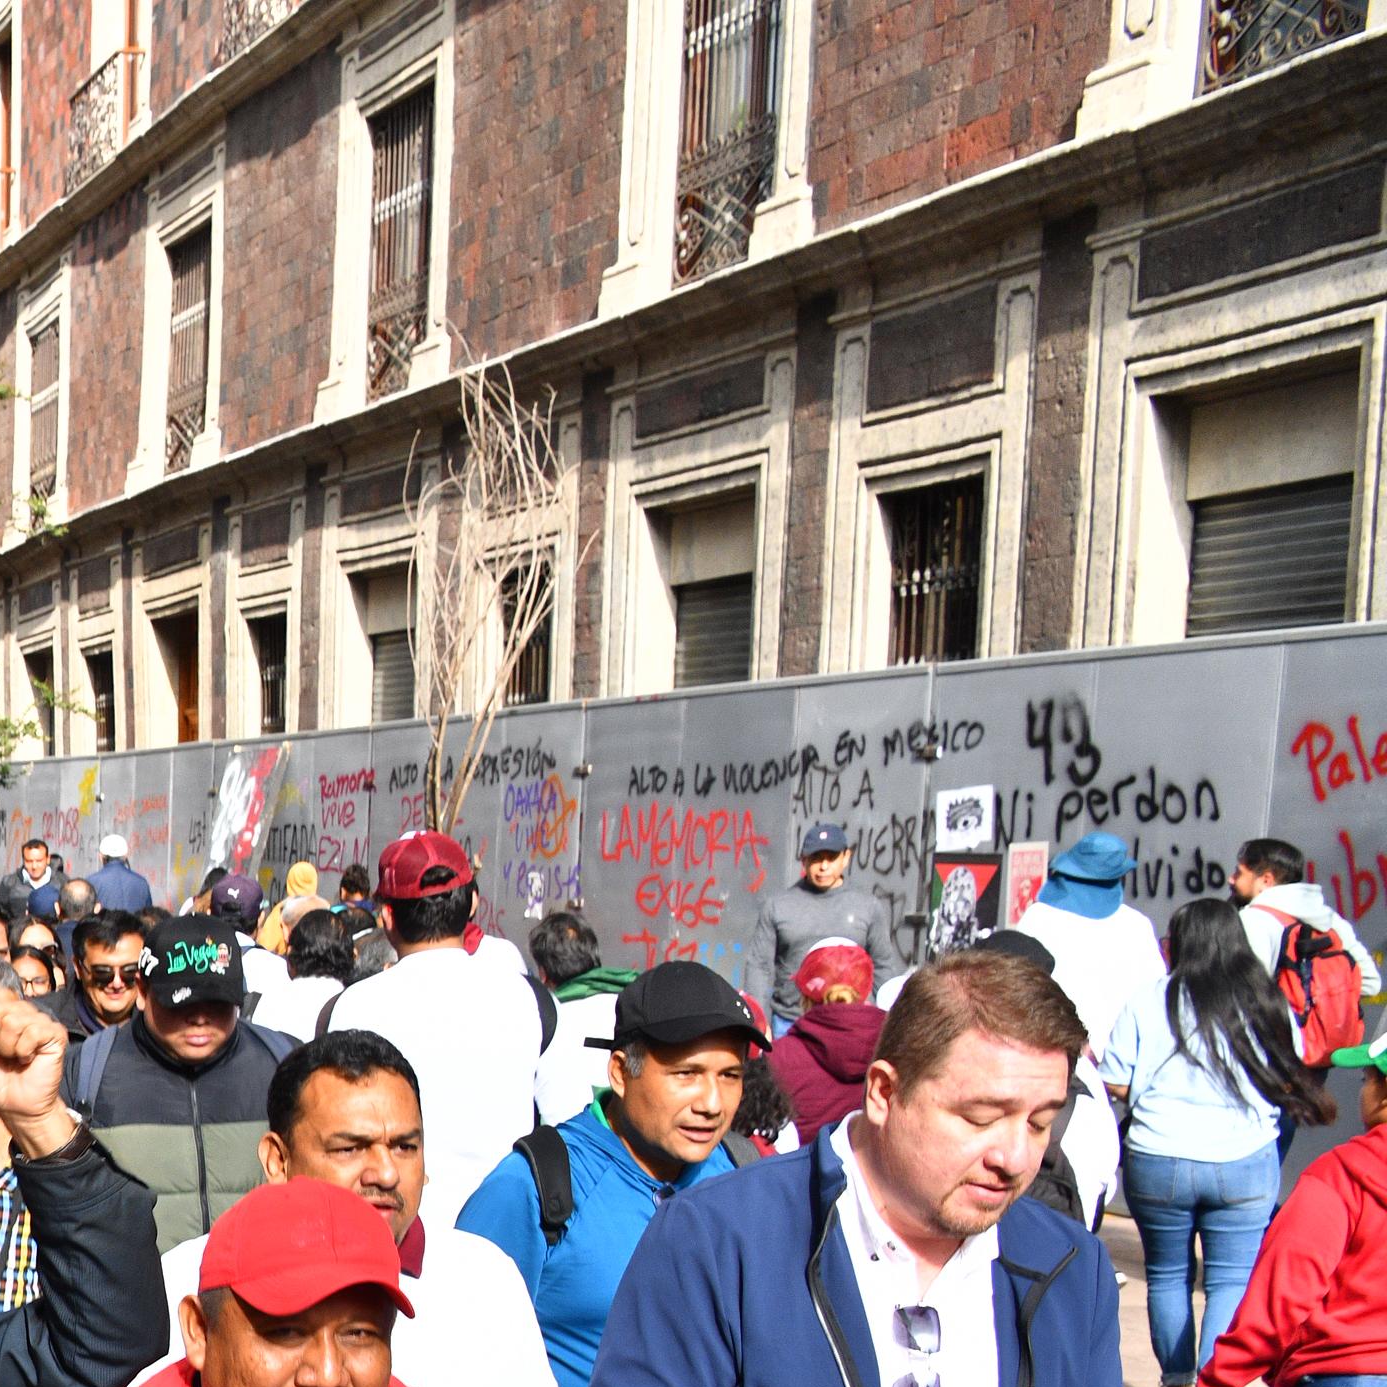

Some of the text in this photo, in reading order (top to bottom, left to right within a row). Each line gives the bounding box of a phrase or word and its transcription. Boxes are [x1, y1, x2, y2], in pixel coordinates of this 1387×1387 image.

[628, 764, 668, 797] ALTO
[673, 769, 685, 797] A
[833, 729, 867, 767] EN
[1026, 694, 1103, 787] 43
[389, 761, 419, 794] ALTO
[851, 767, 875, 811] A
[1055, 766, 1221, 842] perdon
[1131, 836, 1227, 899] lvido
